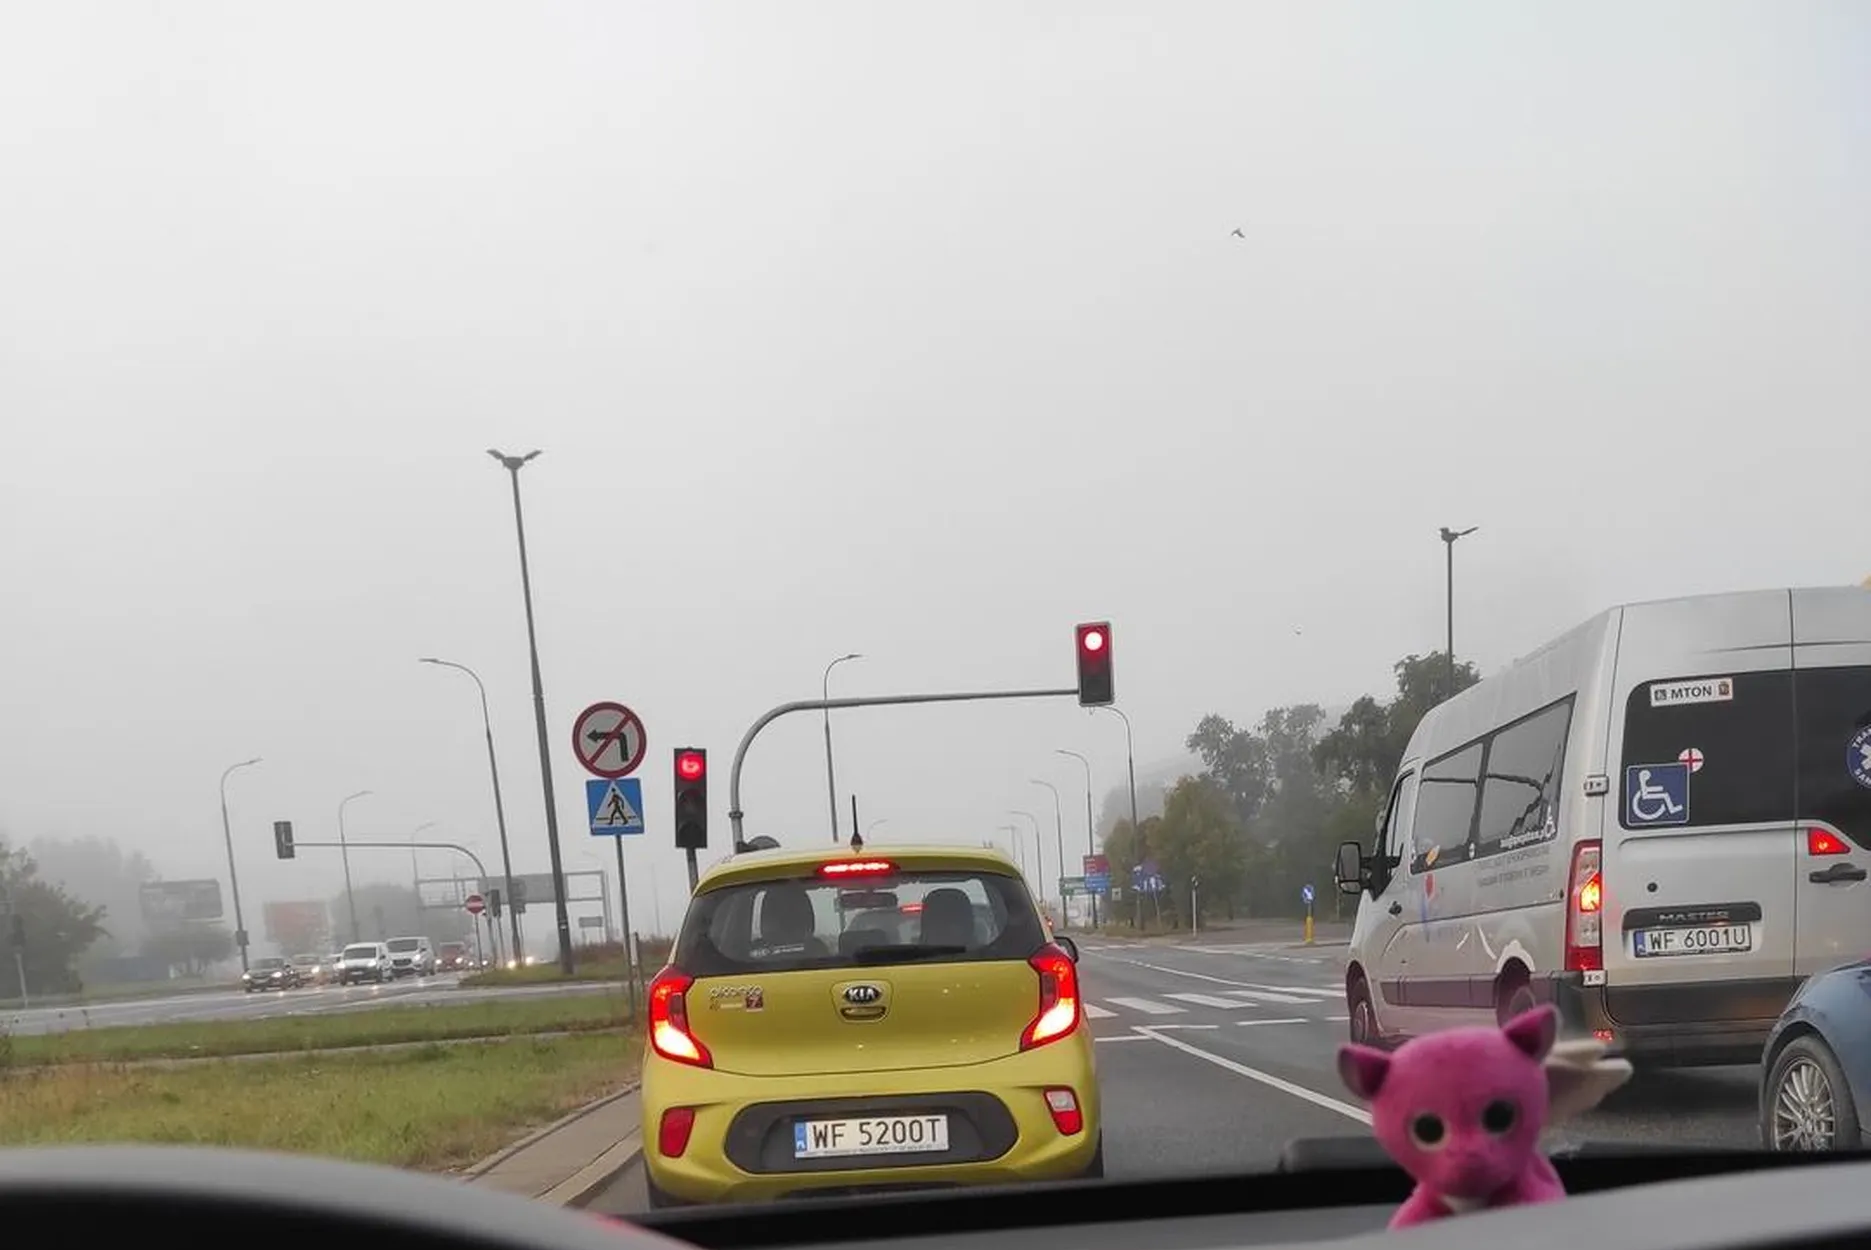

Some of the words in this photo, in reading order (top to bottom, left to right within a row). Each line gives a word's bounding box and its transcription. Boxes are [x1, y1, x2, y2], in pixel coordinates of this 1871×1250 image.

[1671, 685, 1713, 700] MTON
[1650, 931, 1675, 949] WF
[1684, 928, 1746, 948] 6001U
[848, 988, 876, 1001] KIA
[812, 1122, 847, 1149] WF
[859, 1118, 941, 1146] 5200T
